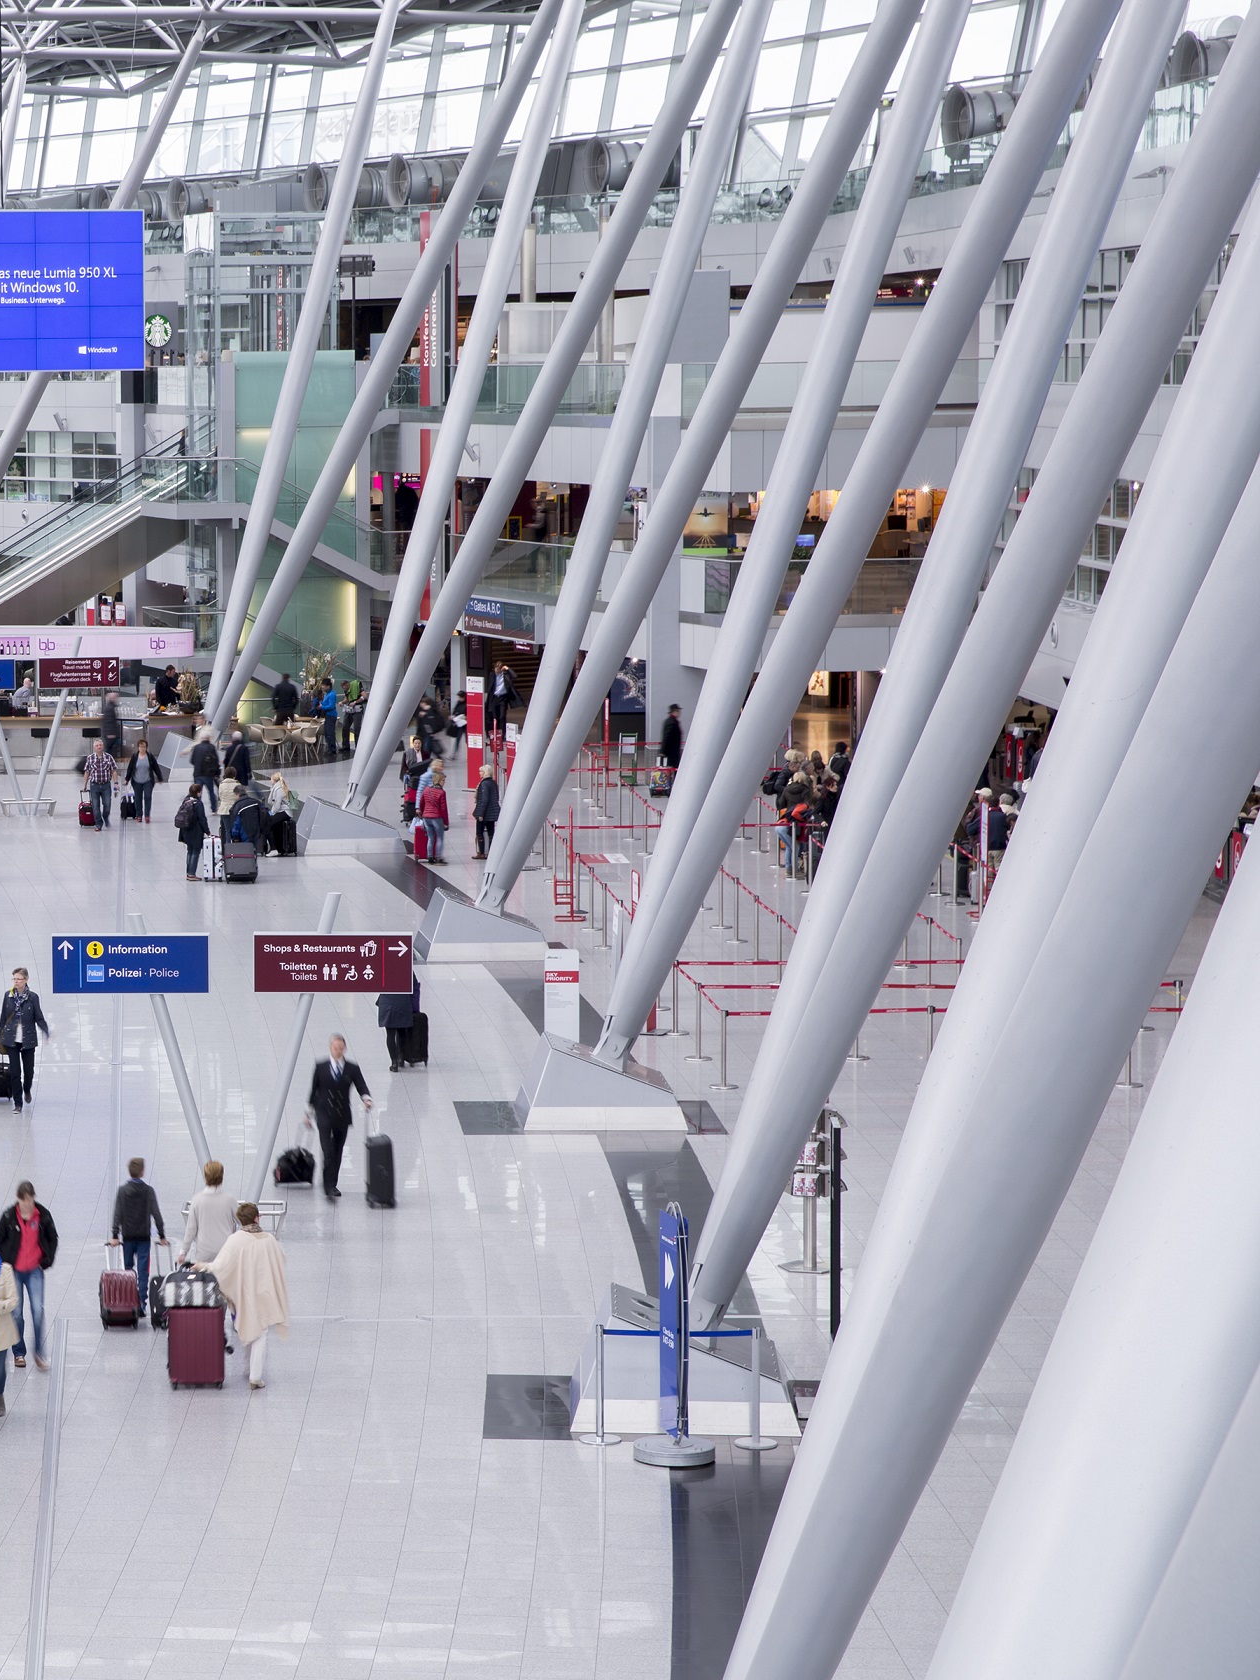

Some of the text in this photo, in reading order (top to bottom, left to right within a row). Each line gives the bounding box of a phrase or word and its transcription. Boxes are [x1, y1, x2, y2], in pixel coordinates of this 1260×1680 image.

[14, 270, 40, 279] neue
[44, 267, 76, 278] Lumia
[79, 267, 100, 278] 950
[103, 267, 118, 278] XL
[10, 282, 62, 294] Windows
[64, 282, 80, 293] 10.
[30, 297, 66, 305] Unterwegs.
[473, 600, 487, 612] Gates
[473, 618, 482, 628] Shops
[108, 944, 168, 954] Information
[263, 944, 356, 954] Shops & Restaurants
[279, 962, 318, 971] Toiletten
[108, 968, 142, 978] Polizei
[149, 968, 180, 978] Police
[290, 972, 318, 980] Toilets
